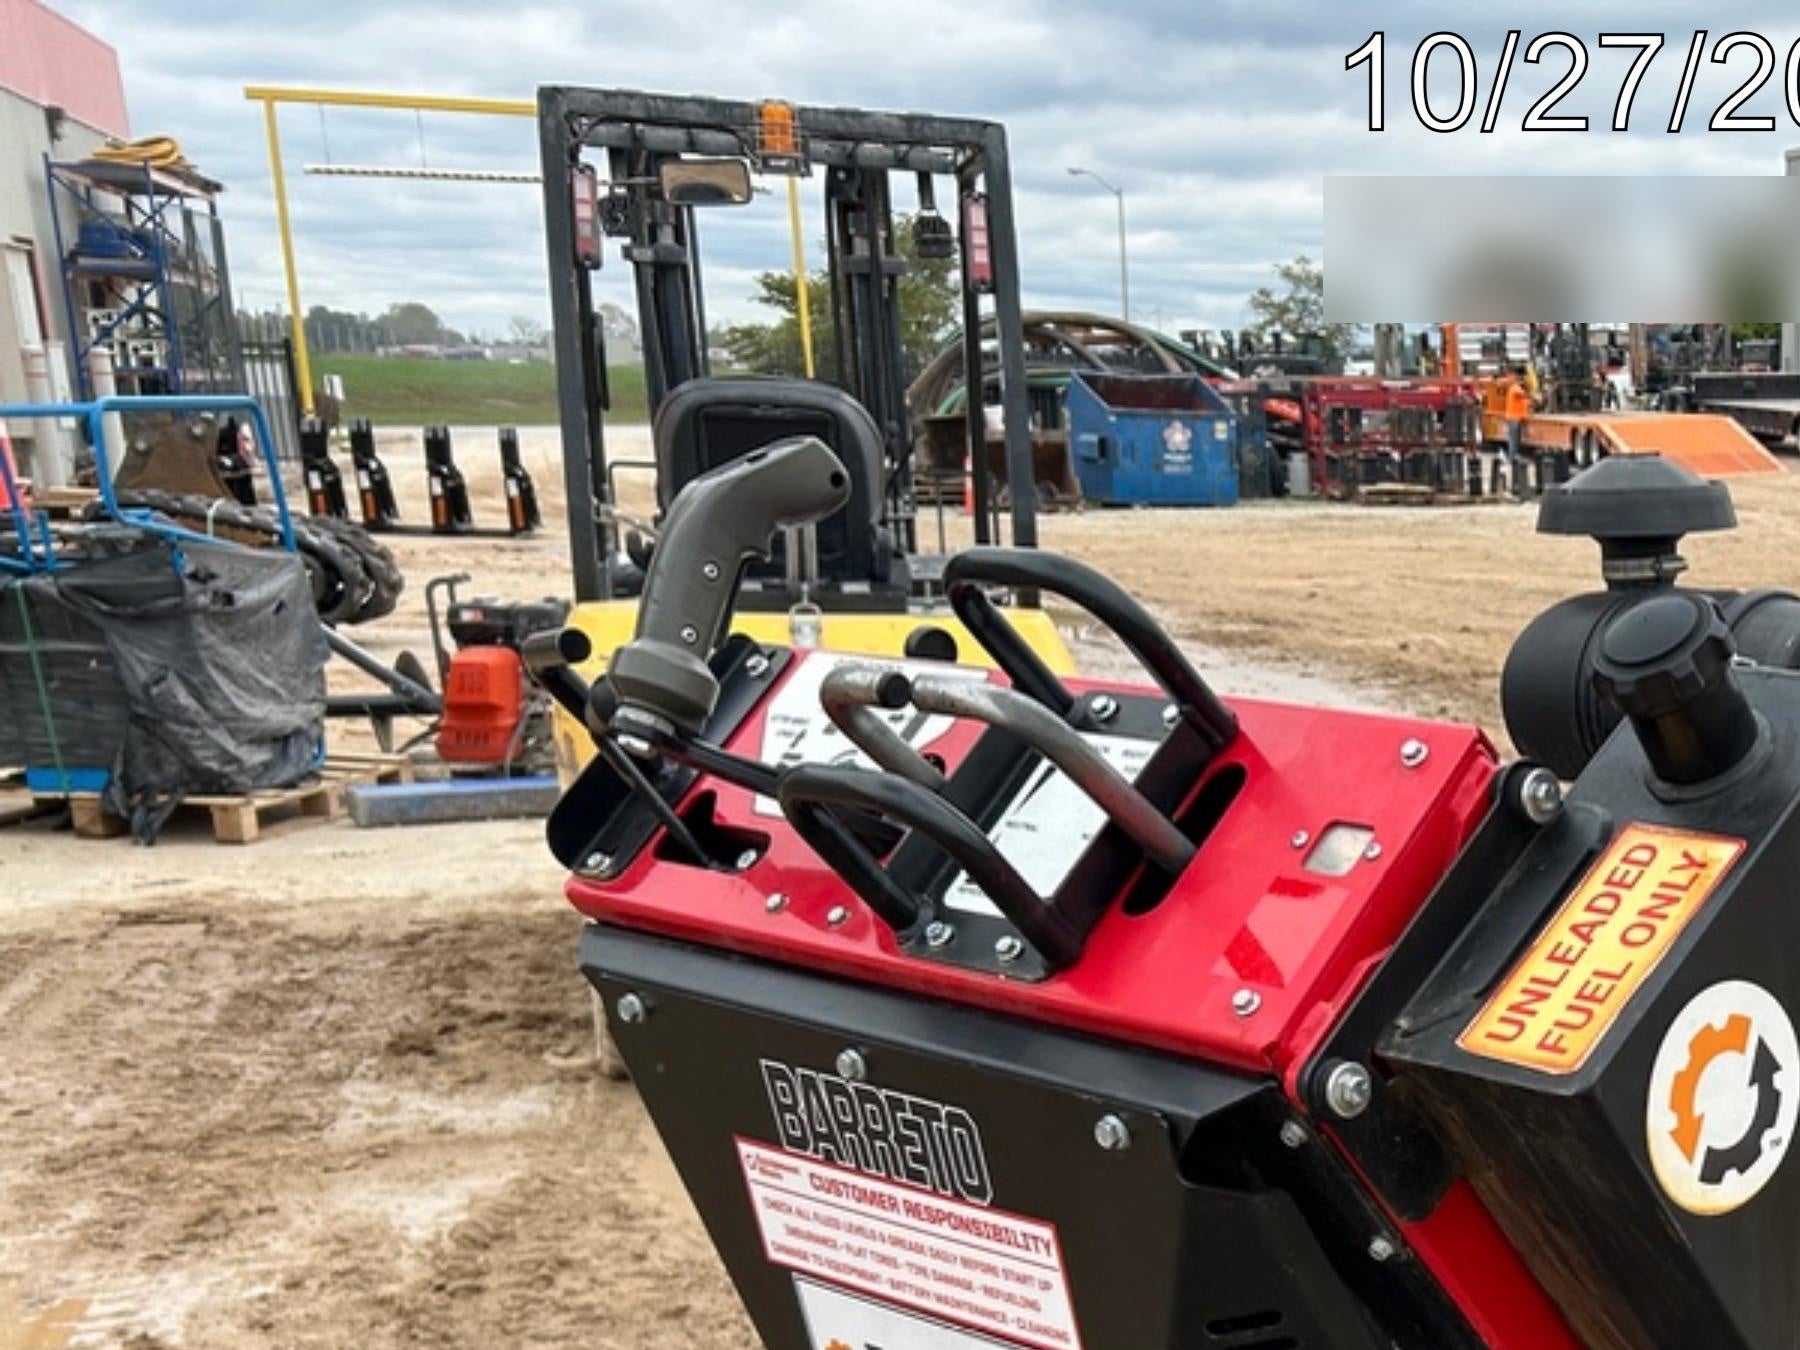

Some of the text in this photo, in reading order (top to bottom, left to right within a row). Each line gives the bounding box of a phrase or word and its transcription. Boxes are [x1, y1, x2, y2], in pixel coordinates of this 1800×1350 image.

[1486, 842, 1659, 1044] UNLEADED
[1536, 850, 1708, 1056] FUEL ONLY
[758, 1057, 993, 1208] BARRETO
[808, 1172, 1052, 1258] CUSTOMER RESPONSIBILITY
